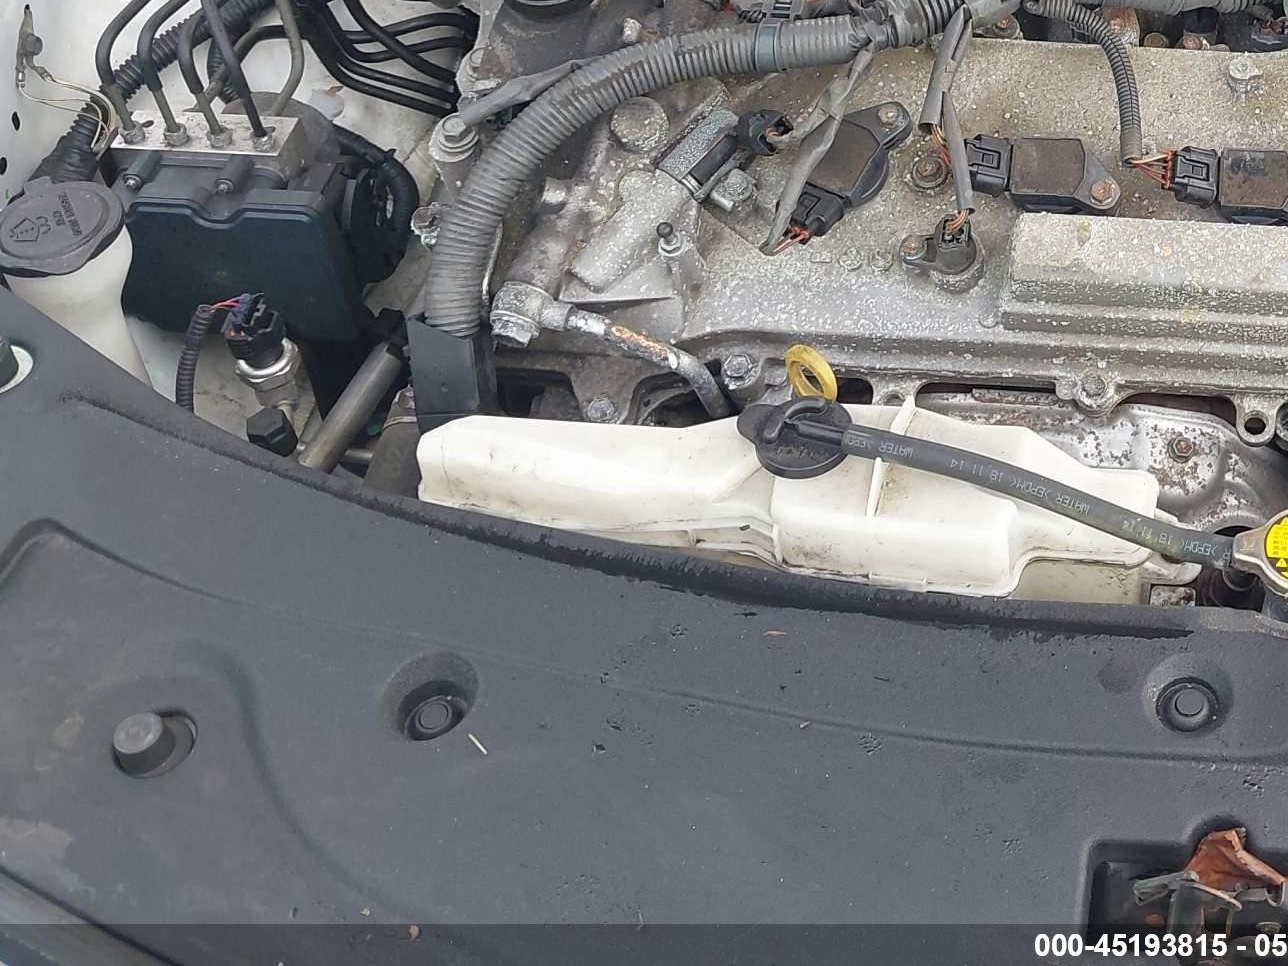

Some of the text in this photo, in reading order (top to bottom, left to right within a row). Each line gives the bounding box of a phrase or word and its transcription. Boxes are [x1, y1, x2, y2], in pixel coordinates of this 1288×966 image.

[878, 441, 915, 458] WATER
[950, 457, 964, 470] 14
[972, 463, 984, 477] 11
[989, 468, 1005, 483] 18
[1055, 493, 1091, 516] WATER
[1158, 533, 1173, 546] 18
